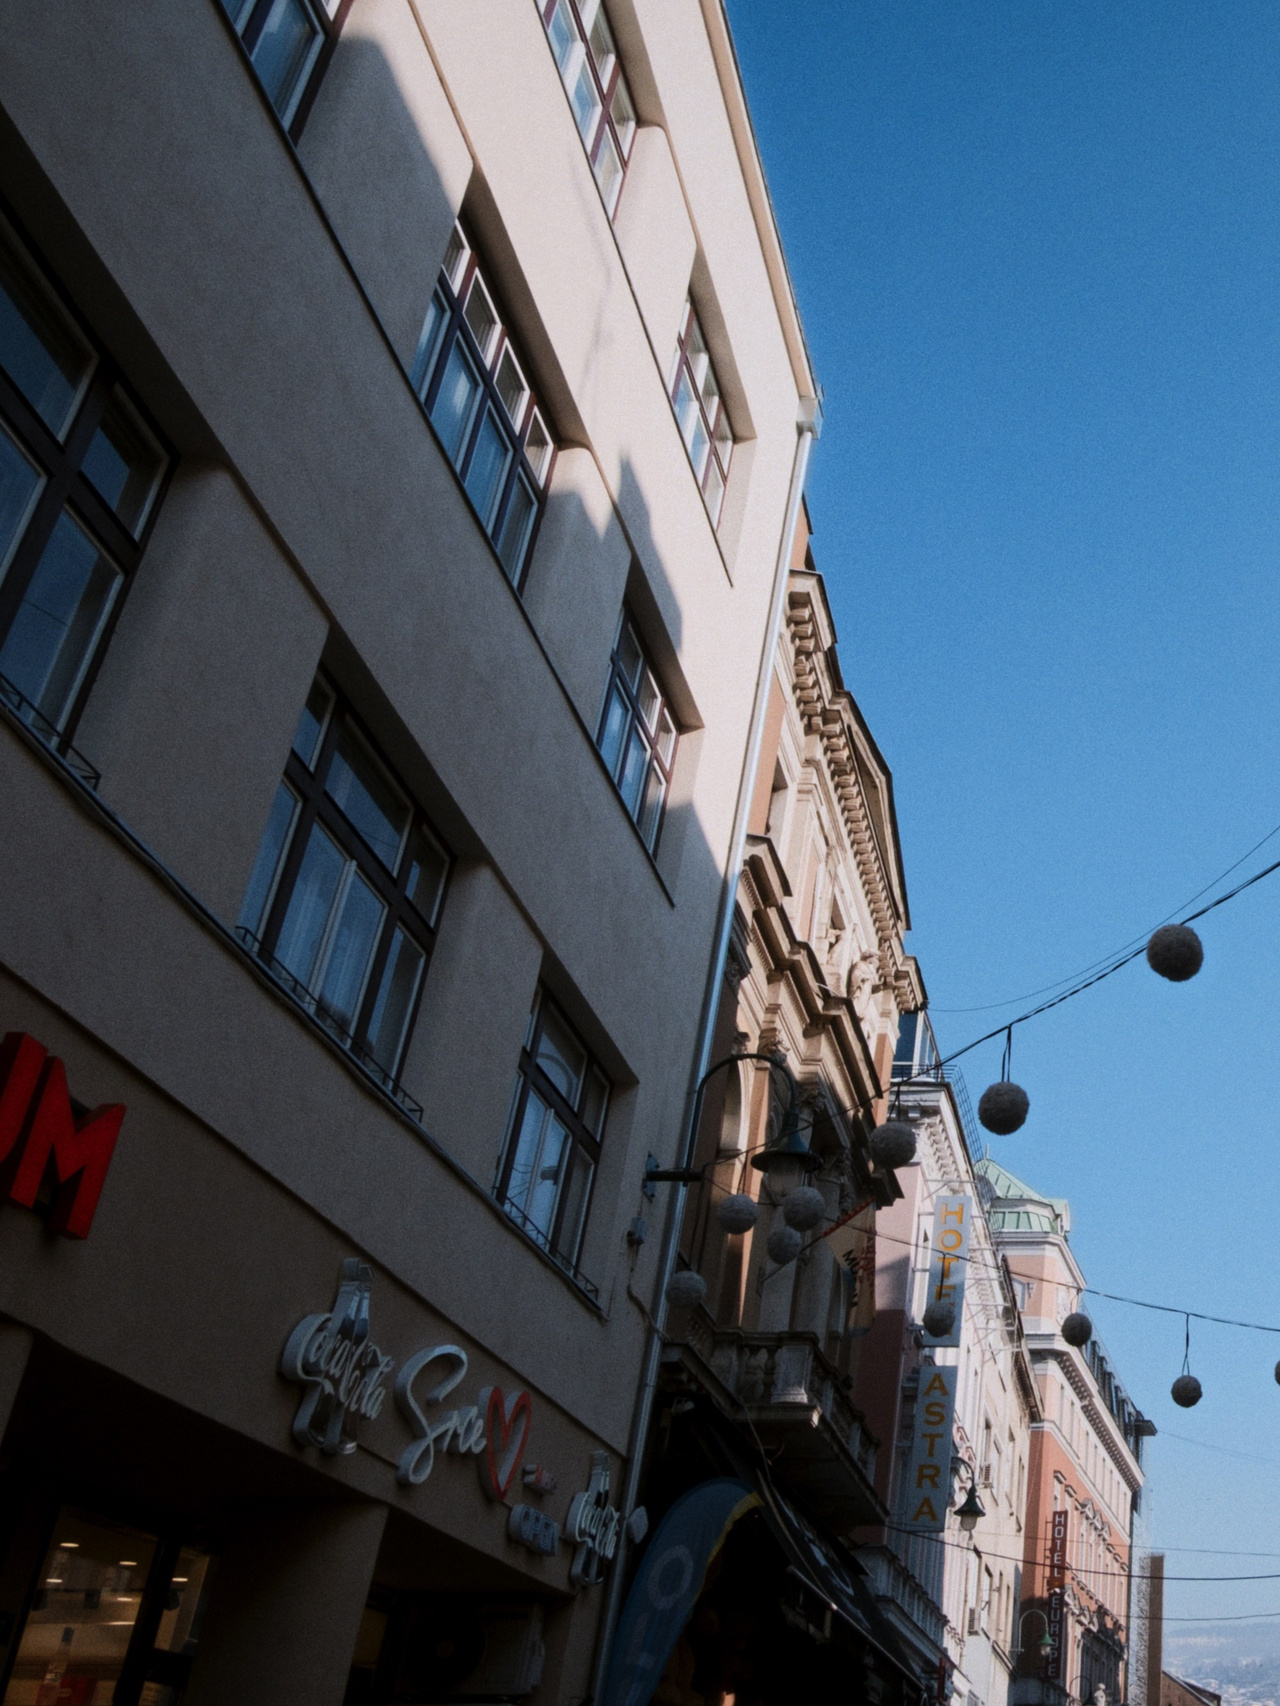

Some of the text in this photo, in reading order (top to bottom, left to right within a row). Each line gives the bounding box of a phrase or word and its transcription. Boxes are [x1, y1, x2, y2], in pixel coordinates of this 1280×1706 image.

[934, 1203, 965, 1335] HOTE
[911, 1372, 950, 1522] ASTRA
[1053, 1513, 1066, 1578] HOTEL
